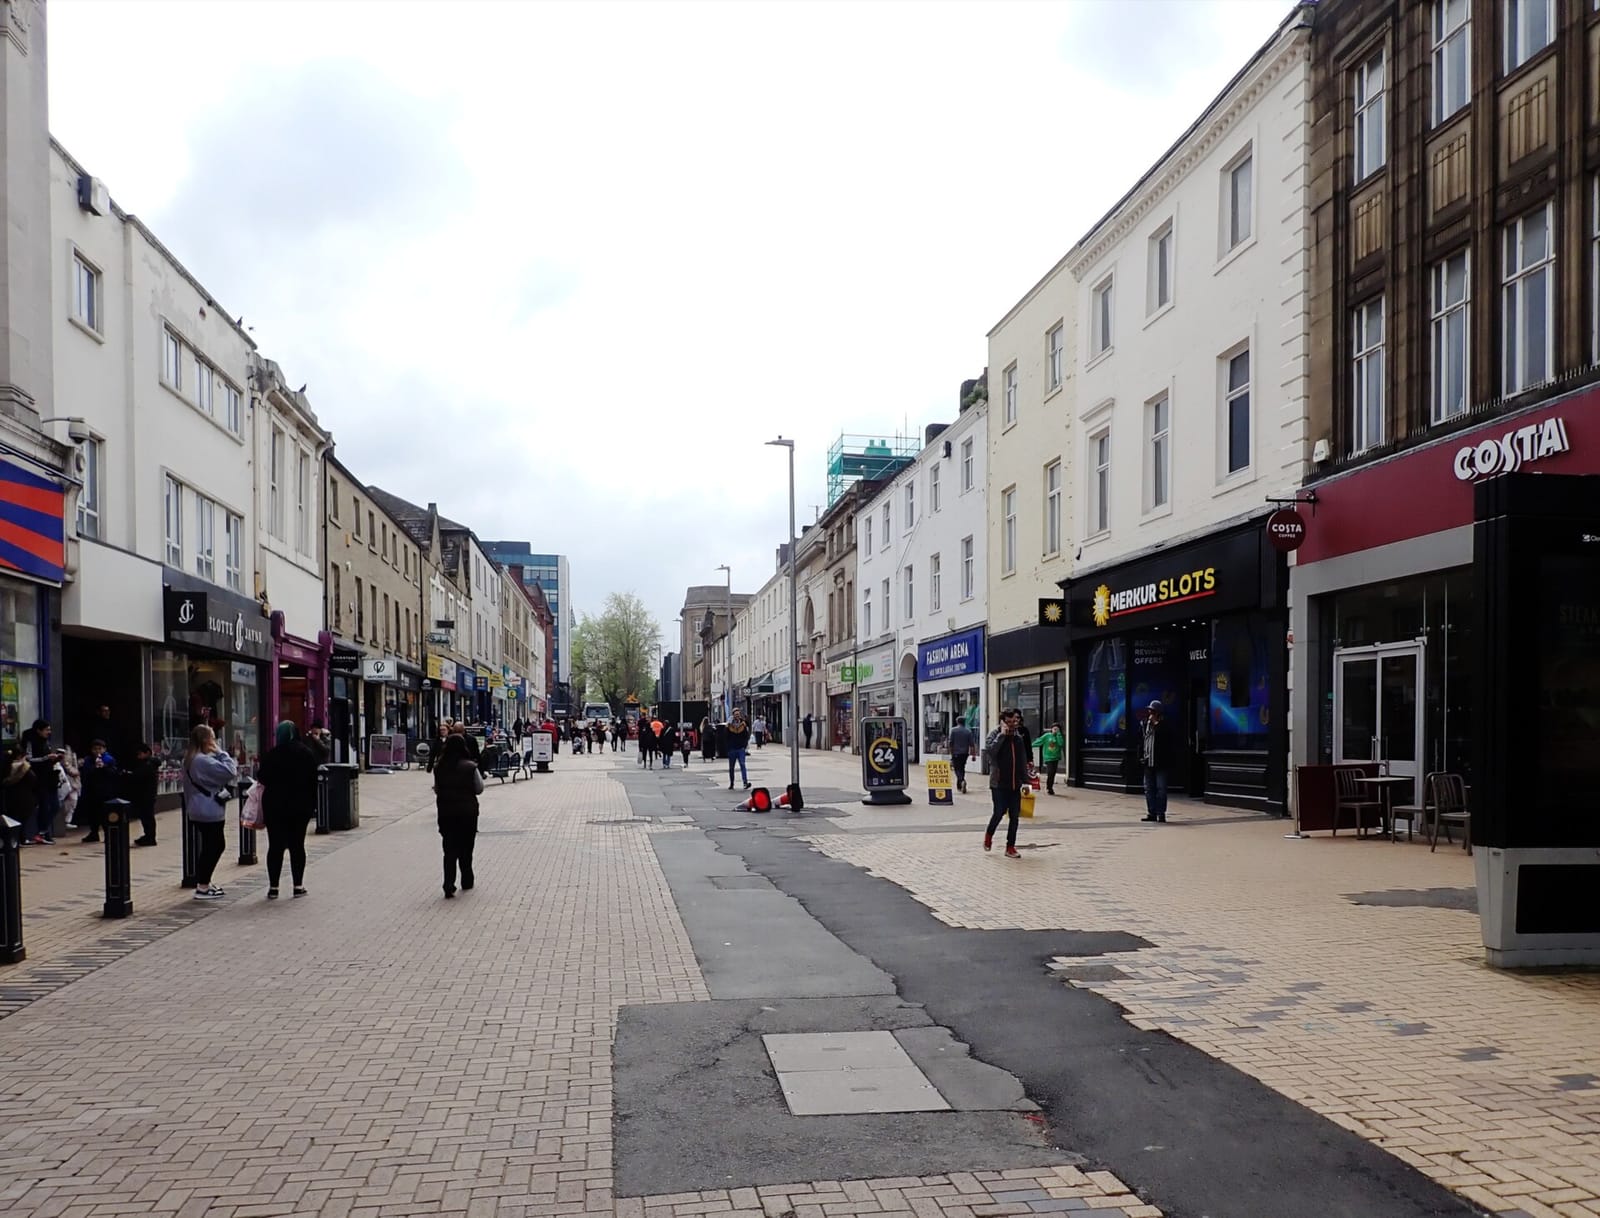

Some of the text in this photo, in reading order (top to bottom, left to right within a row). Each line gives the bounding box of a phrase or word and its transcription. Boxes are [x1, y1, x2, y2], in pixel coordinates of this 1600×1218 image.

[1454, 417, 1570, 481] COSTA
[1271, 523, 1302, 533] COSTA
[1110, 567, 1215, 612] MERKUR SLOTS
[926, 641, 969, 666] FASHION ARENA
[1134, 656, 1163, 665] OFFERS
[874, 748, 895, 763] 24
